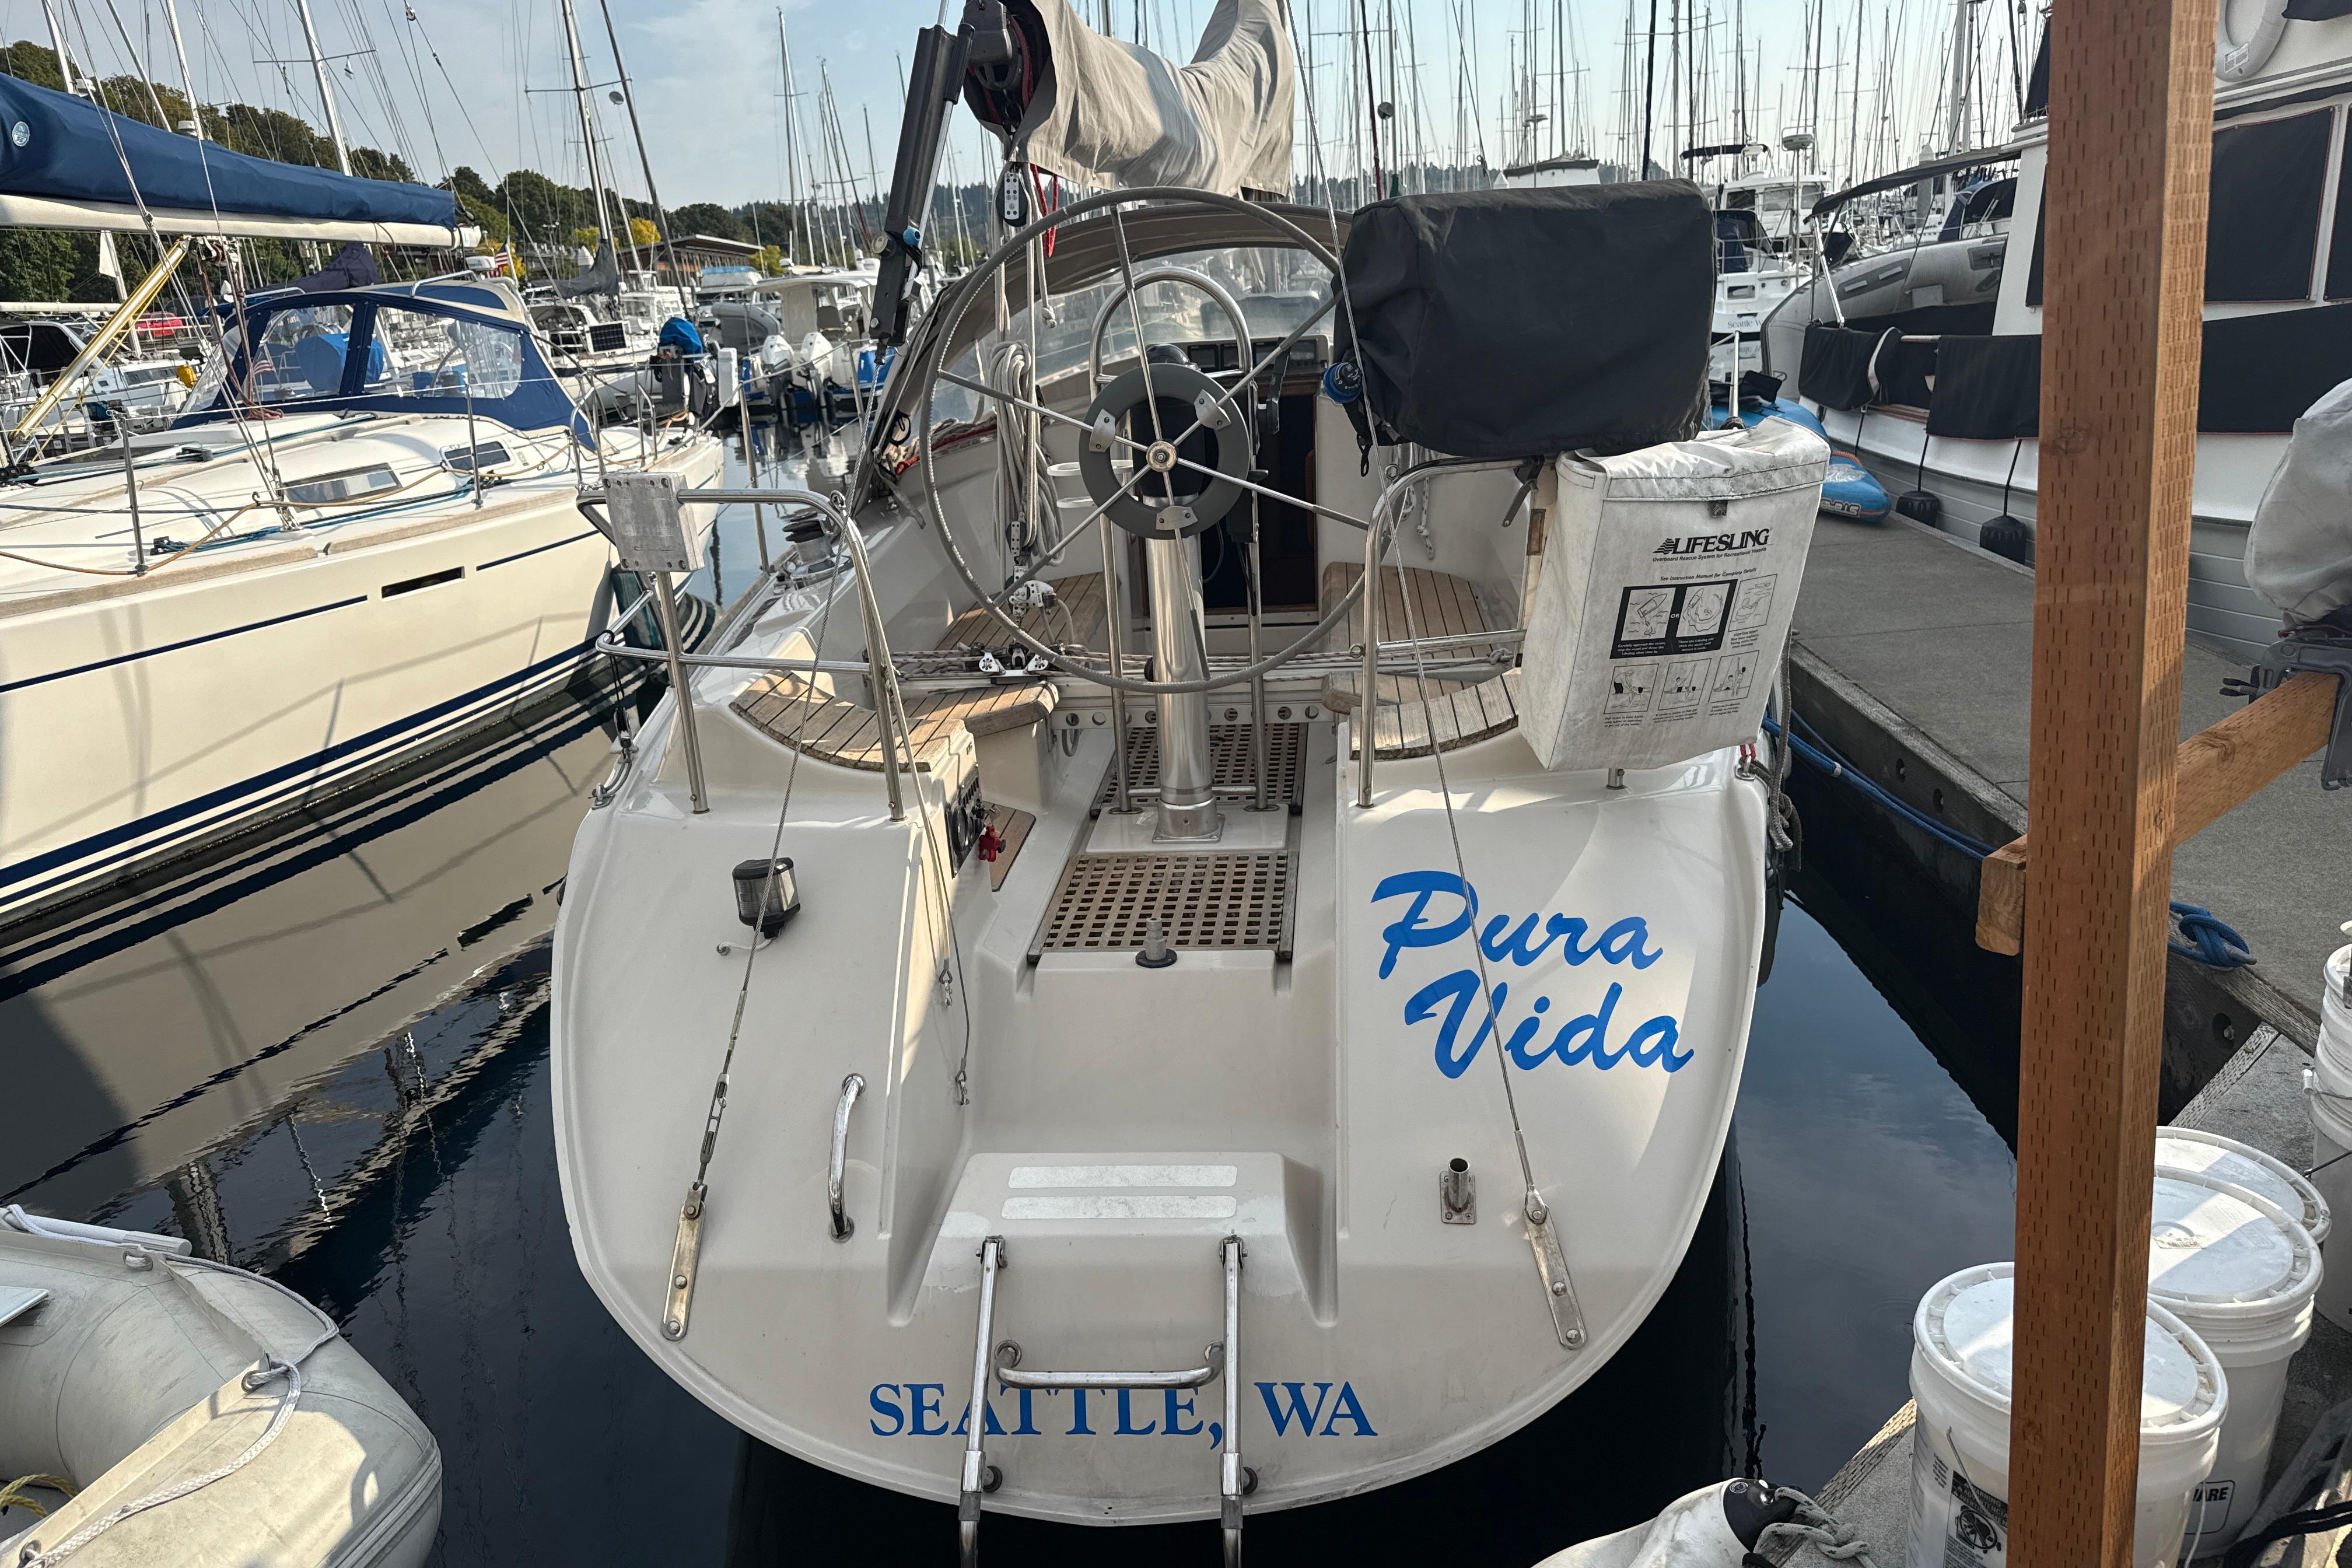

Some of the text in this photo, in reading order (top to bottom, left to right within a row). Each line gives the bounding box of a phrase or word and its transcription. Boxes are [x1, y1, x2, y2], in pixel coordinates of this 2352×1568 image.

[1672, 528, 1770, 554] LIFESLING
[1371, 870, 1662, 979] Pura
[1404, 970, 1695, 1079] Vida
[1254, 1381, 1378, 1437] WA
